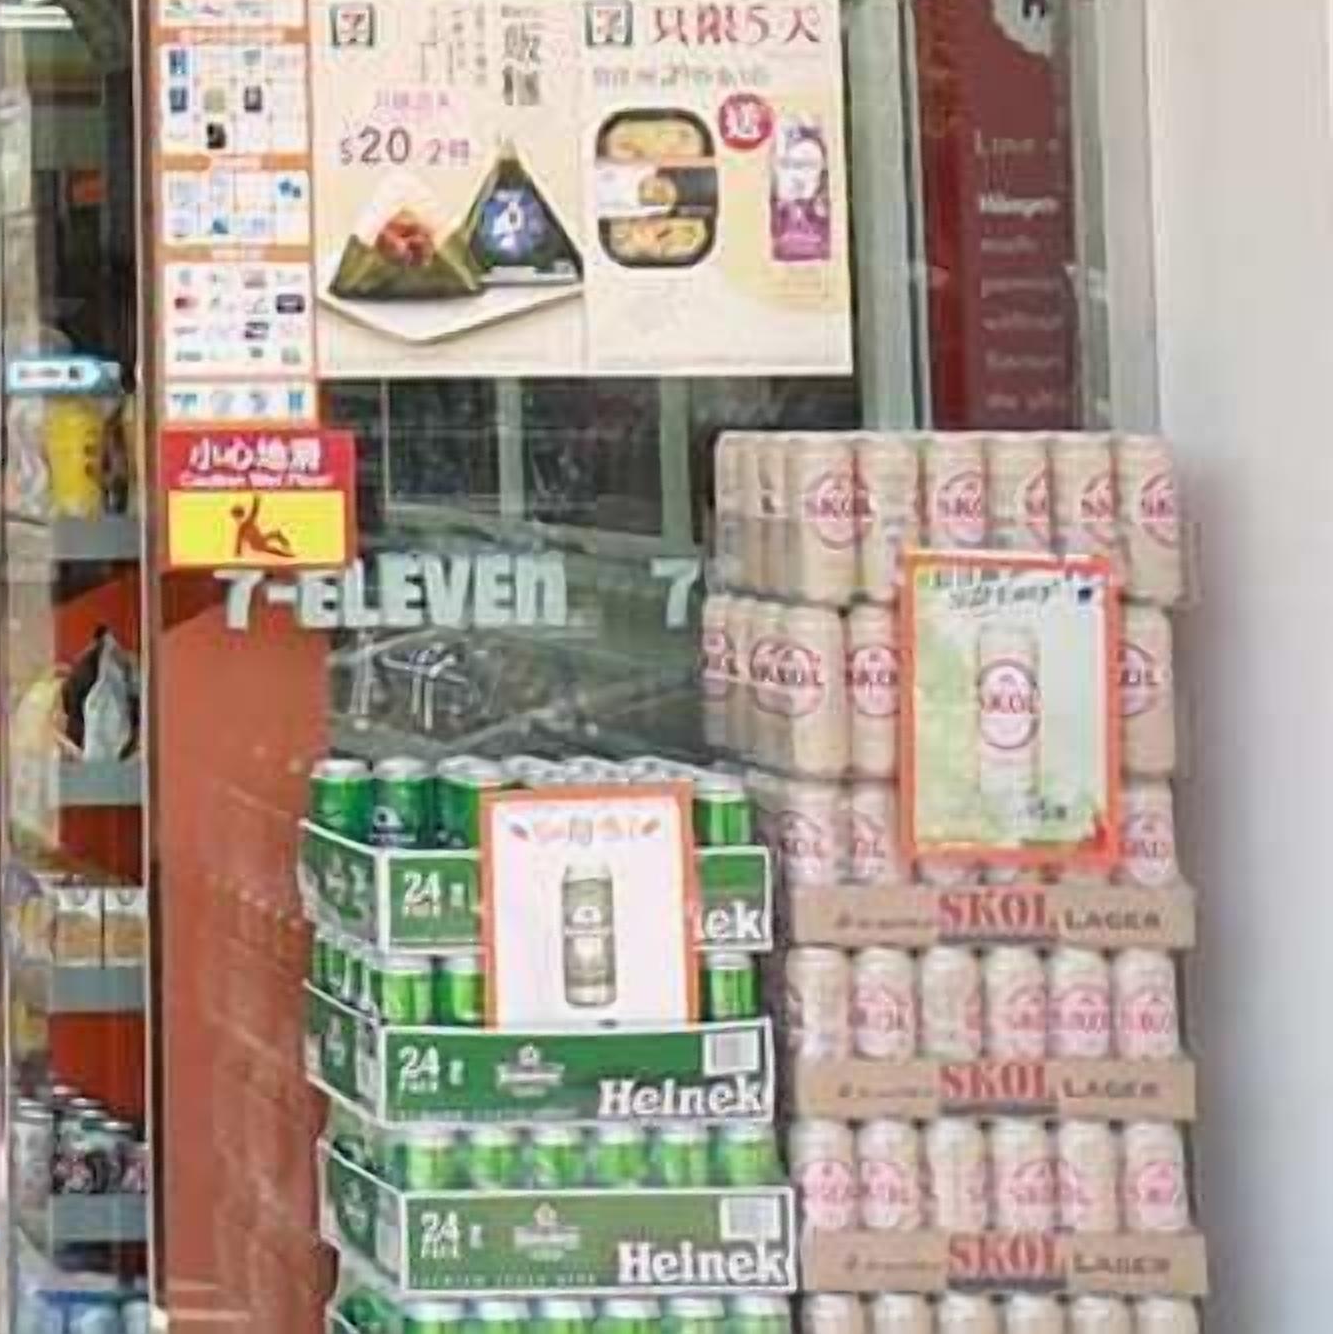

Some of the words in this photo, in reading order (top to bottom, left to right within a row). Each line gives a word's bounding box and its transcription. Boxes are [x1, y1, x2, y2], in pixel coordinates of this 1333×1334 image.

[403, 871, 440, 905] 24
[937, 891, 1059, 931] SKOL
[397, 1045, 440, 1077] 24
[938, 1062, 1059, 1100] SKOL
[948, 1232, 1070, 1277] SKOL
